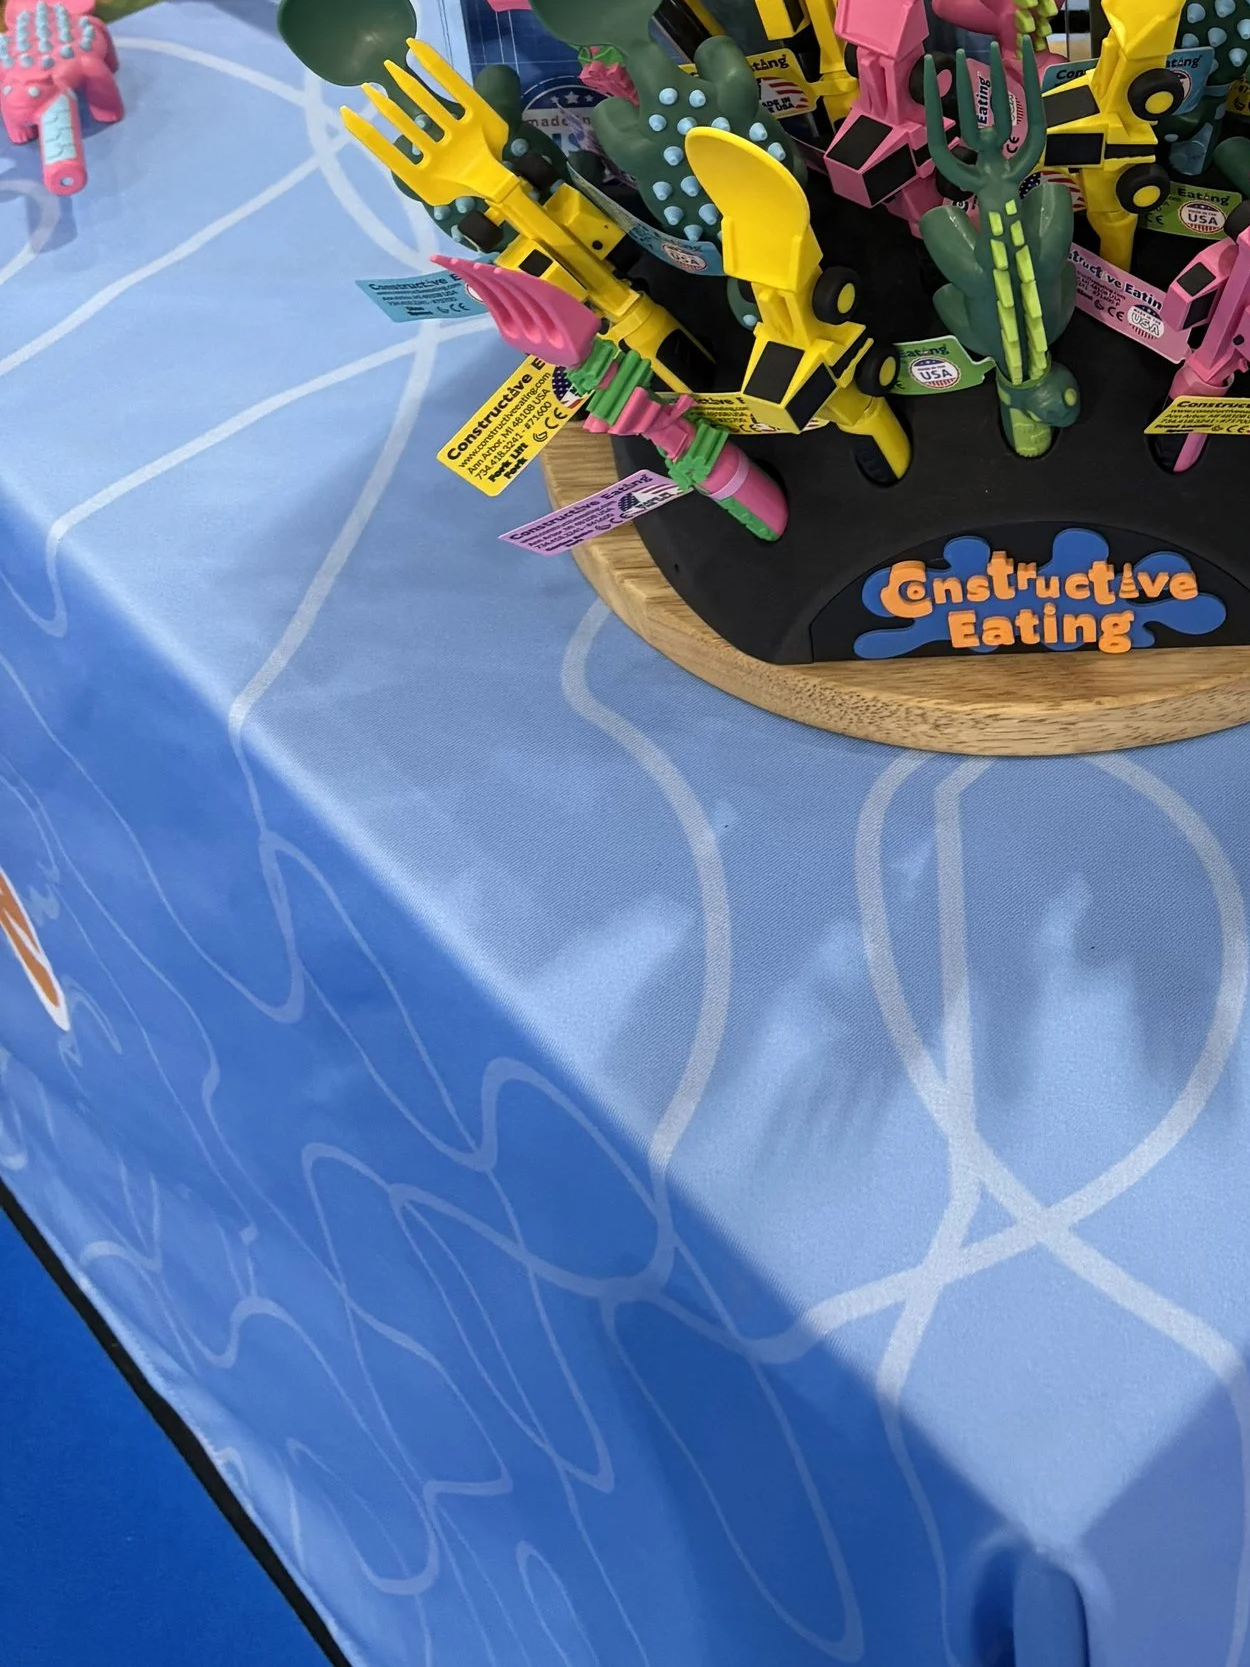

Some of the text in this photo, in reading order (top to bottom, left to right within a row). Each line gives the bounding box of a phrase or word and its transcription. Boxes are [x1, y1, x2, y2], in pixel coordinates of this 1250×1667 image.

[751, 53, 790, 72] ting
[1166, 56, 1201, 71] ting
[976, 75, 992, 125] Eating
[1177, 188, 1231, 207] Eating
[1188, 214, 1218, 226] USA
[1124, 282, 1163, 311] Eatin
[1131, 312, 1161, 337] USA
[919, 368, 953, 381] USA
[447, 372, 534, 461] Constructive
[458, 371, 552, 469] www.constructiveeating.com
[467, 387, 551, 475] Ann Arbor, MI 48108 USA
[474, 432, 524, 482] 734.418.3241
[524, 400, 553, 431] #71600
[503, 456, 529, 480] Fork
[509, 499, 601, 541] Constructive
[600, 473, 654, 505] Eating
[879, 550, 1199, 619] Constructive
[946, 601, 1135, 654] Eating
